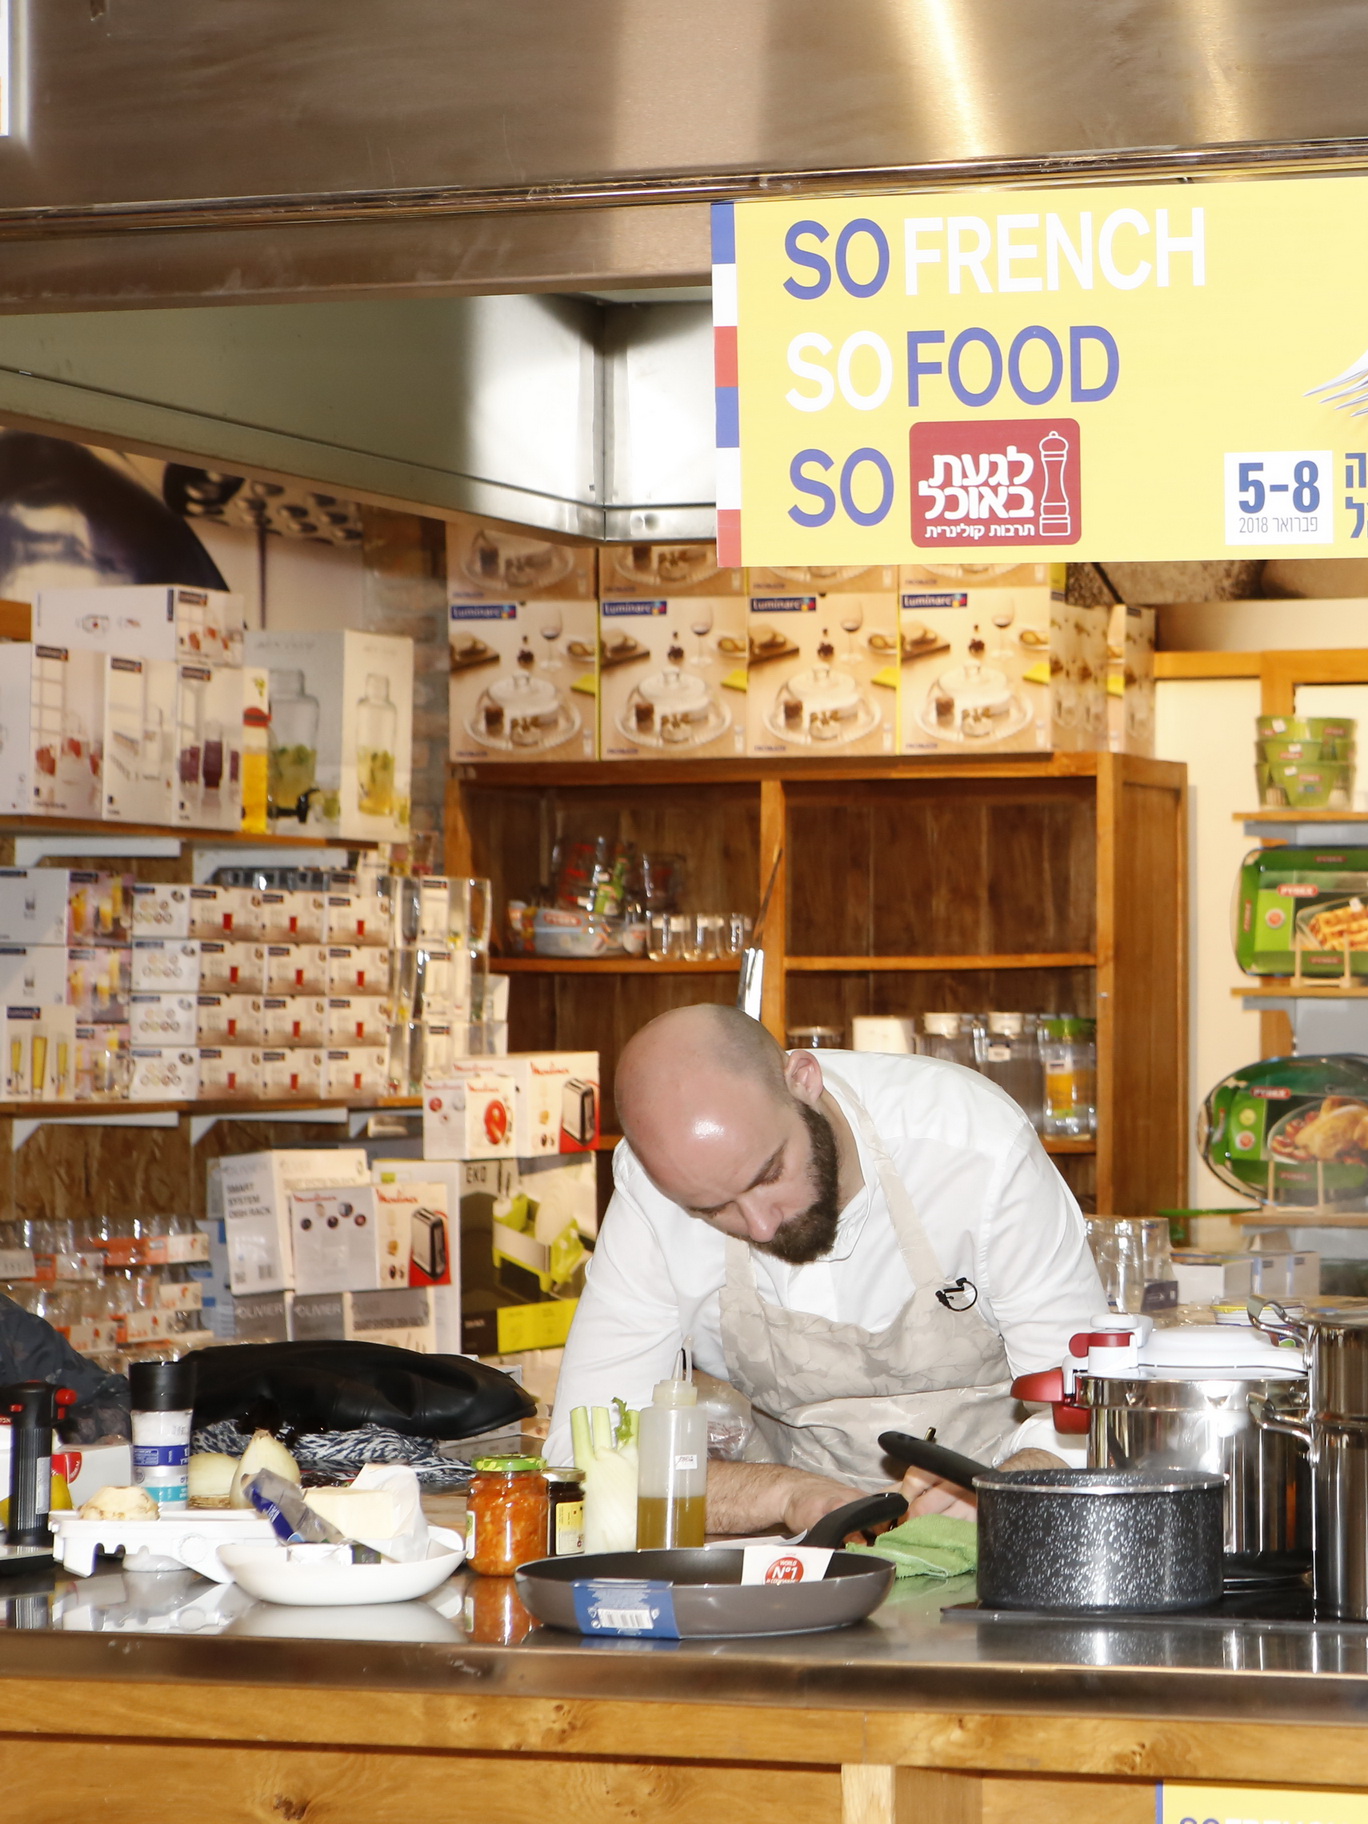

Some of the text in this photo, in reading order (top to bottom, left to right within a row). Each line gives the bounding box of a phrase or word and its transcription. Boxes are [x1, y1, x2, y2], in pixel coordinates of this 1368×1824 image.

[783, 206, 1206, 300] SO FRENCH
[785, 325, 1120, 412] SO FOOD
[928, 445, 1034, 487] לגעת
[787, 447, 895, 528] SO
[918, 480, 1035, 520] באוכל
[925, 523, 1035, 540] תרבות קולינרית
[1239, 516, 1318, 533] פברואר 2018
